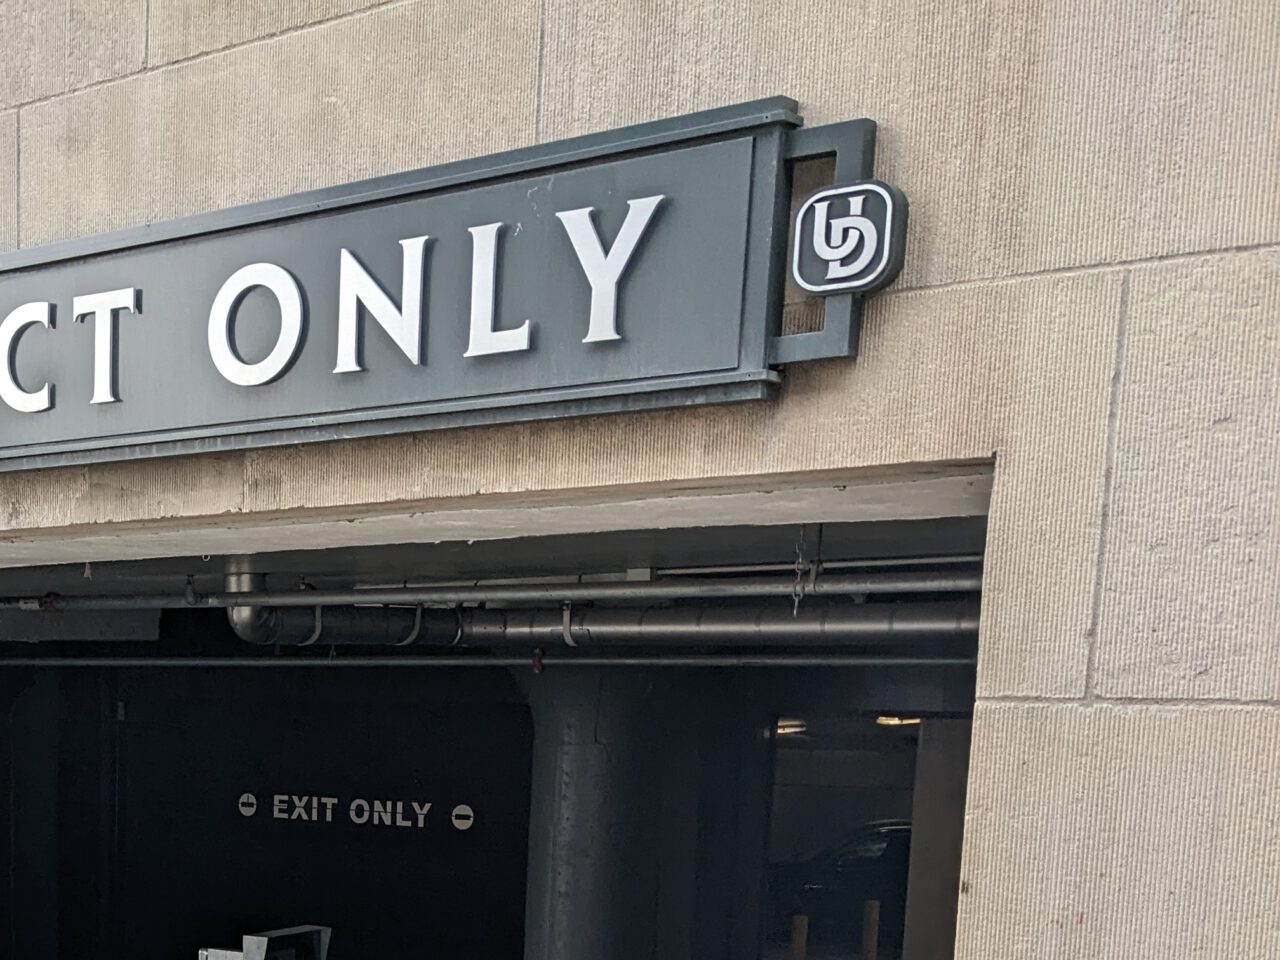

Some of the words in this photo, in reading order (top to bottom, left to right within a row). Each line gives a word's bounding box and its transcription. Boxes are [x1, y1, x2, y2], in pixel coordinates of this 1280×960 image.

[207, 194, 667, 387] ONLY
[272, 794, 339, 822] EXIT
[349, 798, 432, 828] ONLY
